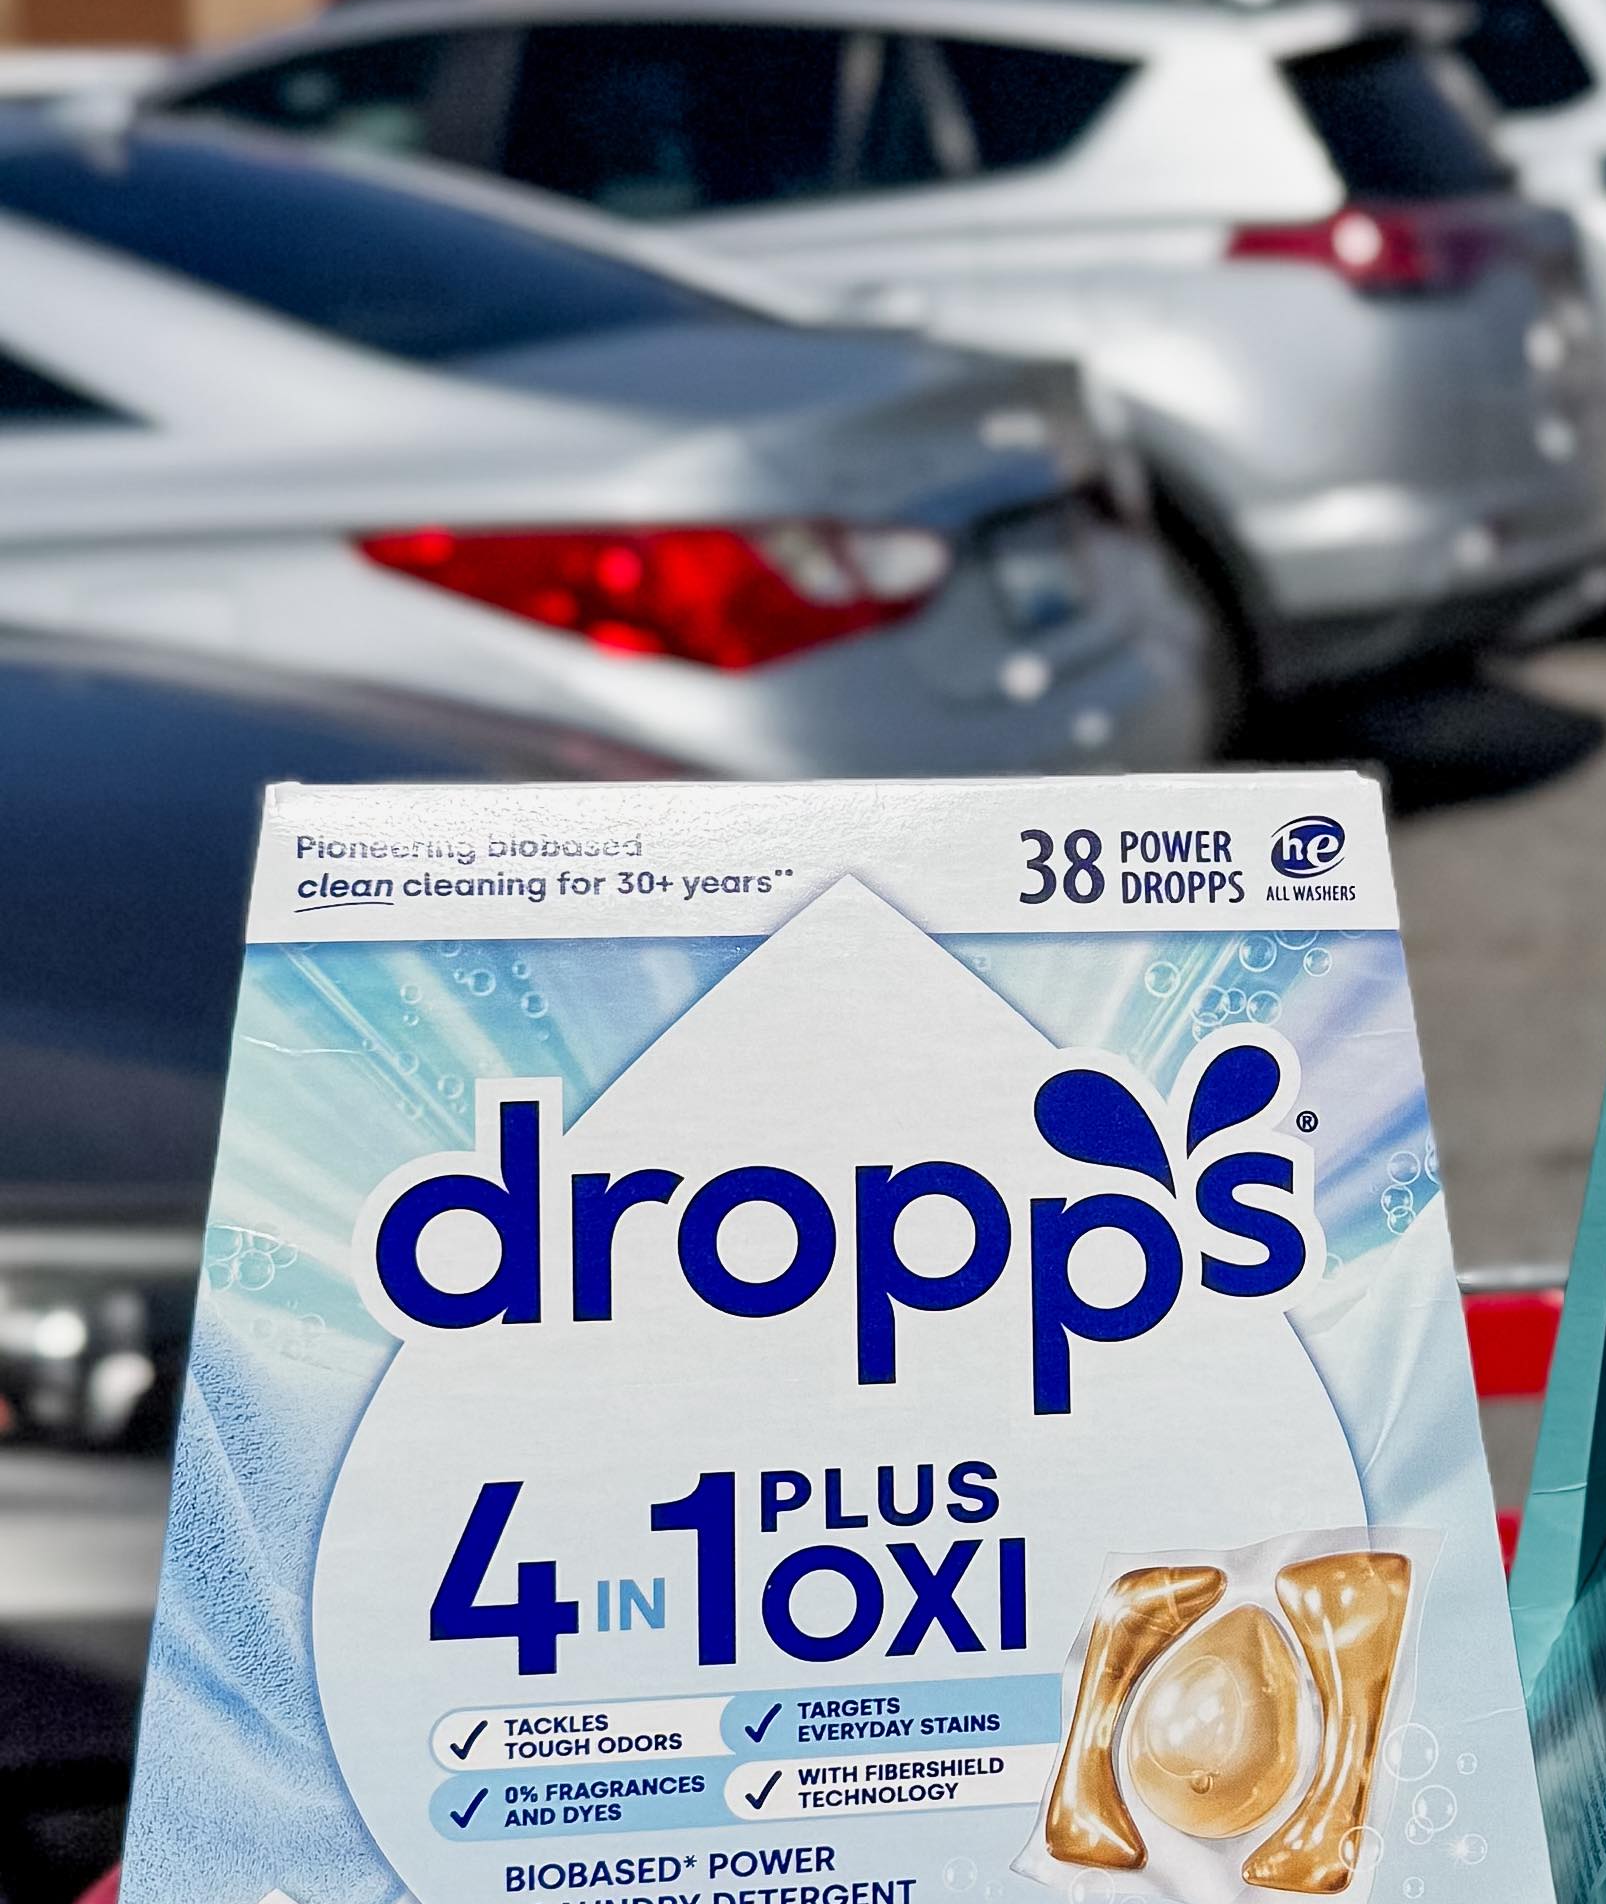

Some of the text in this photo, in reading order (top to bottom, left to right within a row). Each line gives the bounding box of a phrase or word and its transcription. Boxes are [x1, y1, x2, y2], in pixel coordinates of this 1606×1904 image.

[1019, 828, 1232, 905] 38 POWER
[297, 875, 393, 899] clean
[403, 872, 546, 901] cleaning
[557, 871, 606, 896] for
[617, 872, 671, 895] 30+
[1121, 870, 1245, 904] DROPPS
[1266, 885, 1356, 901] ALL WASHERS
[760, 1460, 1000, 1533] PLUS
[428, 1470, 738, 1676] 4 IN 1
[760, 1536, 1028, 1663] OXI
[797, 1697, 901, 1720] TARGETS
[504, 1714, 609, 1736] TACKLES
[798, 1713, 1001, 1743] EVERYDAY STAINS
[505, 1732, 683, 1761] TOUGH ODORS
[798, 1757, 1005, 1786] WITH FIBERSHIELD
[504, 1774, 706, 1807] 0% FRAGRANCES
[798, 1781, 959, 1809] TECHNOLOGY
[504, 1803, 622, 1828] AND DYES
[708, 1845, 836, 1880] POWER
